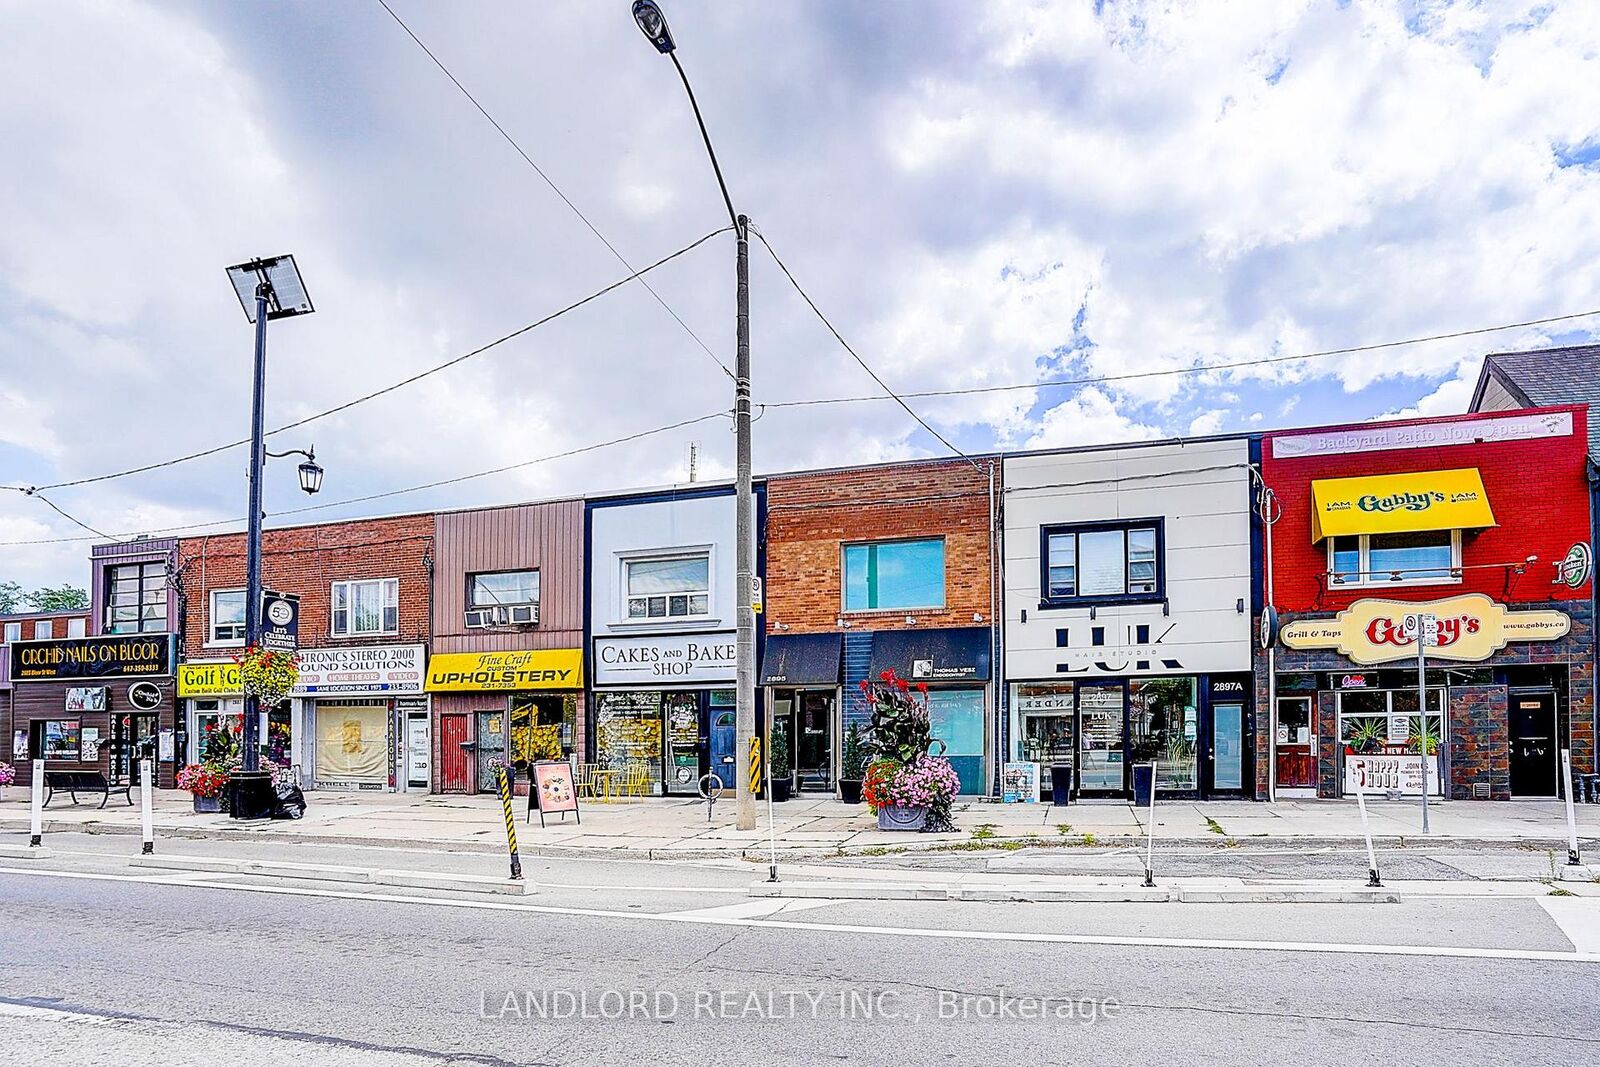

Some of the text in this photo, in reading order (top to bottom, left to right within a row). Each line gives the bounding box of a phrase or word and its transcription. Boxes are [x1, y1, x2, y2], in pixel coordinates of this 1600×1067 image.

[1318, 434, 1390, 450] Backyard
[1396, 430, 1435, 444] Patio
[1443, 427, 1475, 440] Now
[1483, 422, 1531, 439] Open
[1357, 490, 1445, 513] Gabby's
[1287, 630, 1308, 638] Grill
[1322, 629, 1342, 637] Taps
[1365, 615, 1480, 646] Gy's
[21, 643, 159, 665] ORCHID NAILS ON BLOOR
[350, 650, 387, 661] STEREO
[390, 649, 415, 660] 2000
[601, 643, 736, 663] CAKES AND BAKE
[300, 660, 415, 672] OUND SOLUTIONS
[476, 652, 532, 670] Fine Craft
[652, 661, 693, 675] SHOP
[185, 670, 215, 686] Golf
[329, 673, 349, 681] HOME
[351, 673, 378, 681] THEATRE
[432, 669, 572, 684] UPHOLSTERY
[1342, 675, 1367, 688] Open
[1214, 682, 1243, 691] 2897A
[1091, 712, 1112, 720] LUK
[1367, 760, 1399, 774] HAPPY
[1367, 774, 1399, 788] HOUR
